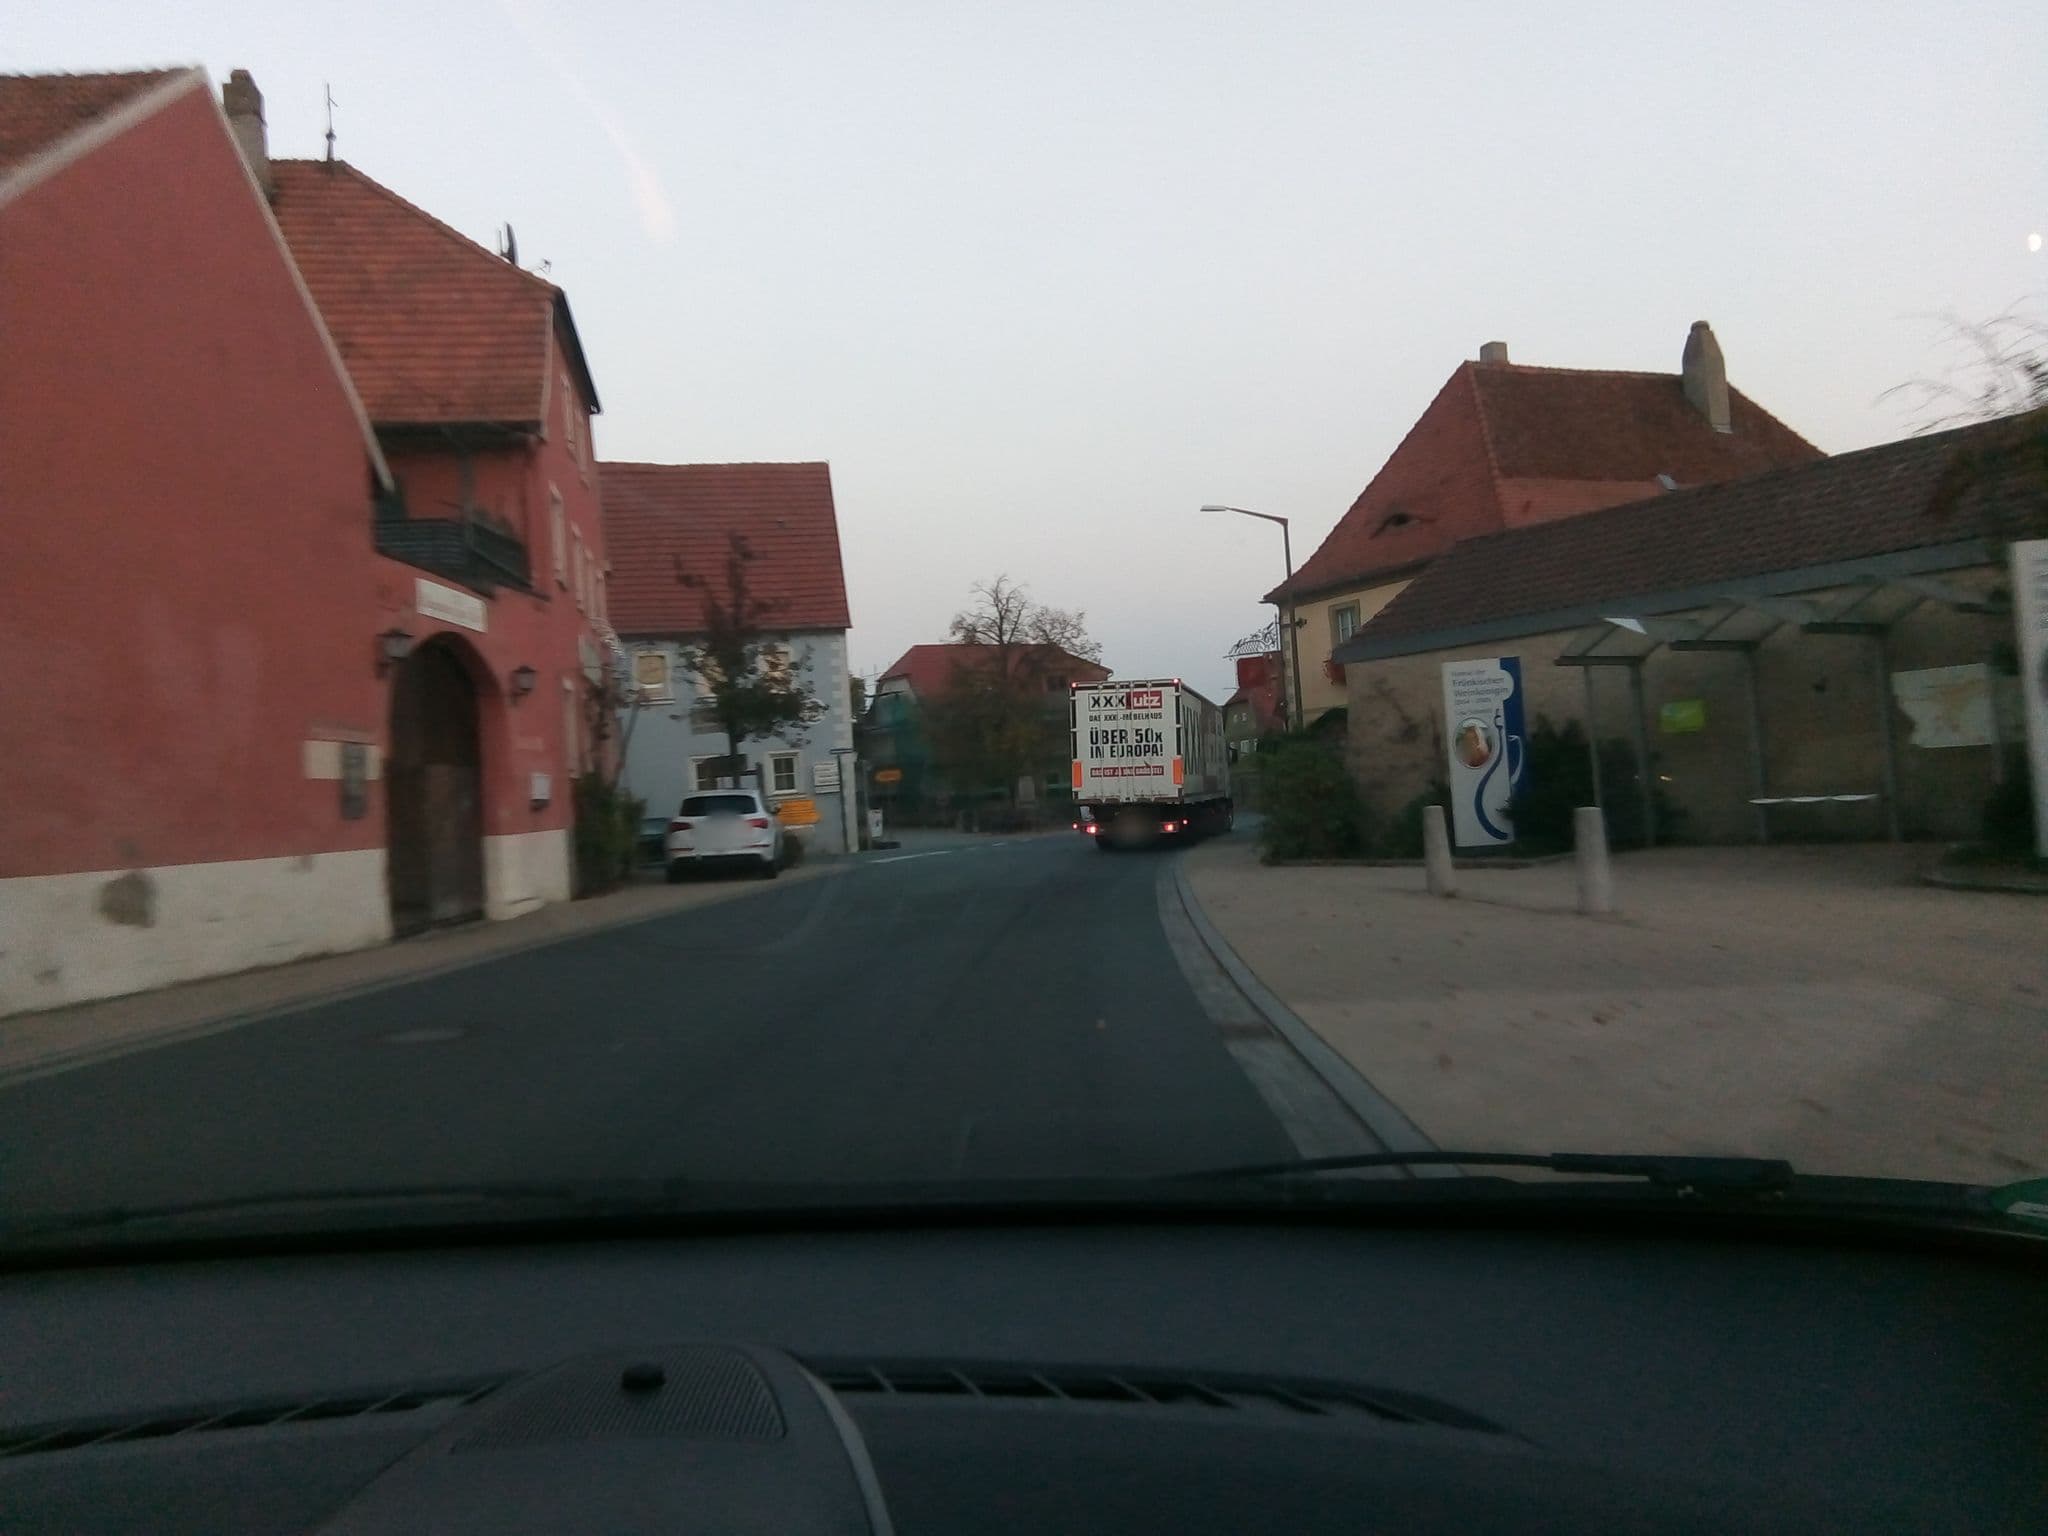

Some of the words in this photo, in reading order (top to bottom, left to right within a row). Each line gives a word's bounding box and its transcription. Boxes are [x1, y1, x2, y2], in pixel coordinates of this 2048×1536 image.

[1089, 727, 1129, 745] ÜBER
[1135, 727, 1163, 743] 50x
[1089, 746, 1105, 759] IN
[1110, 744, 1164, 758] EUROPA!
